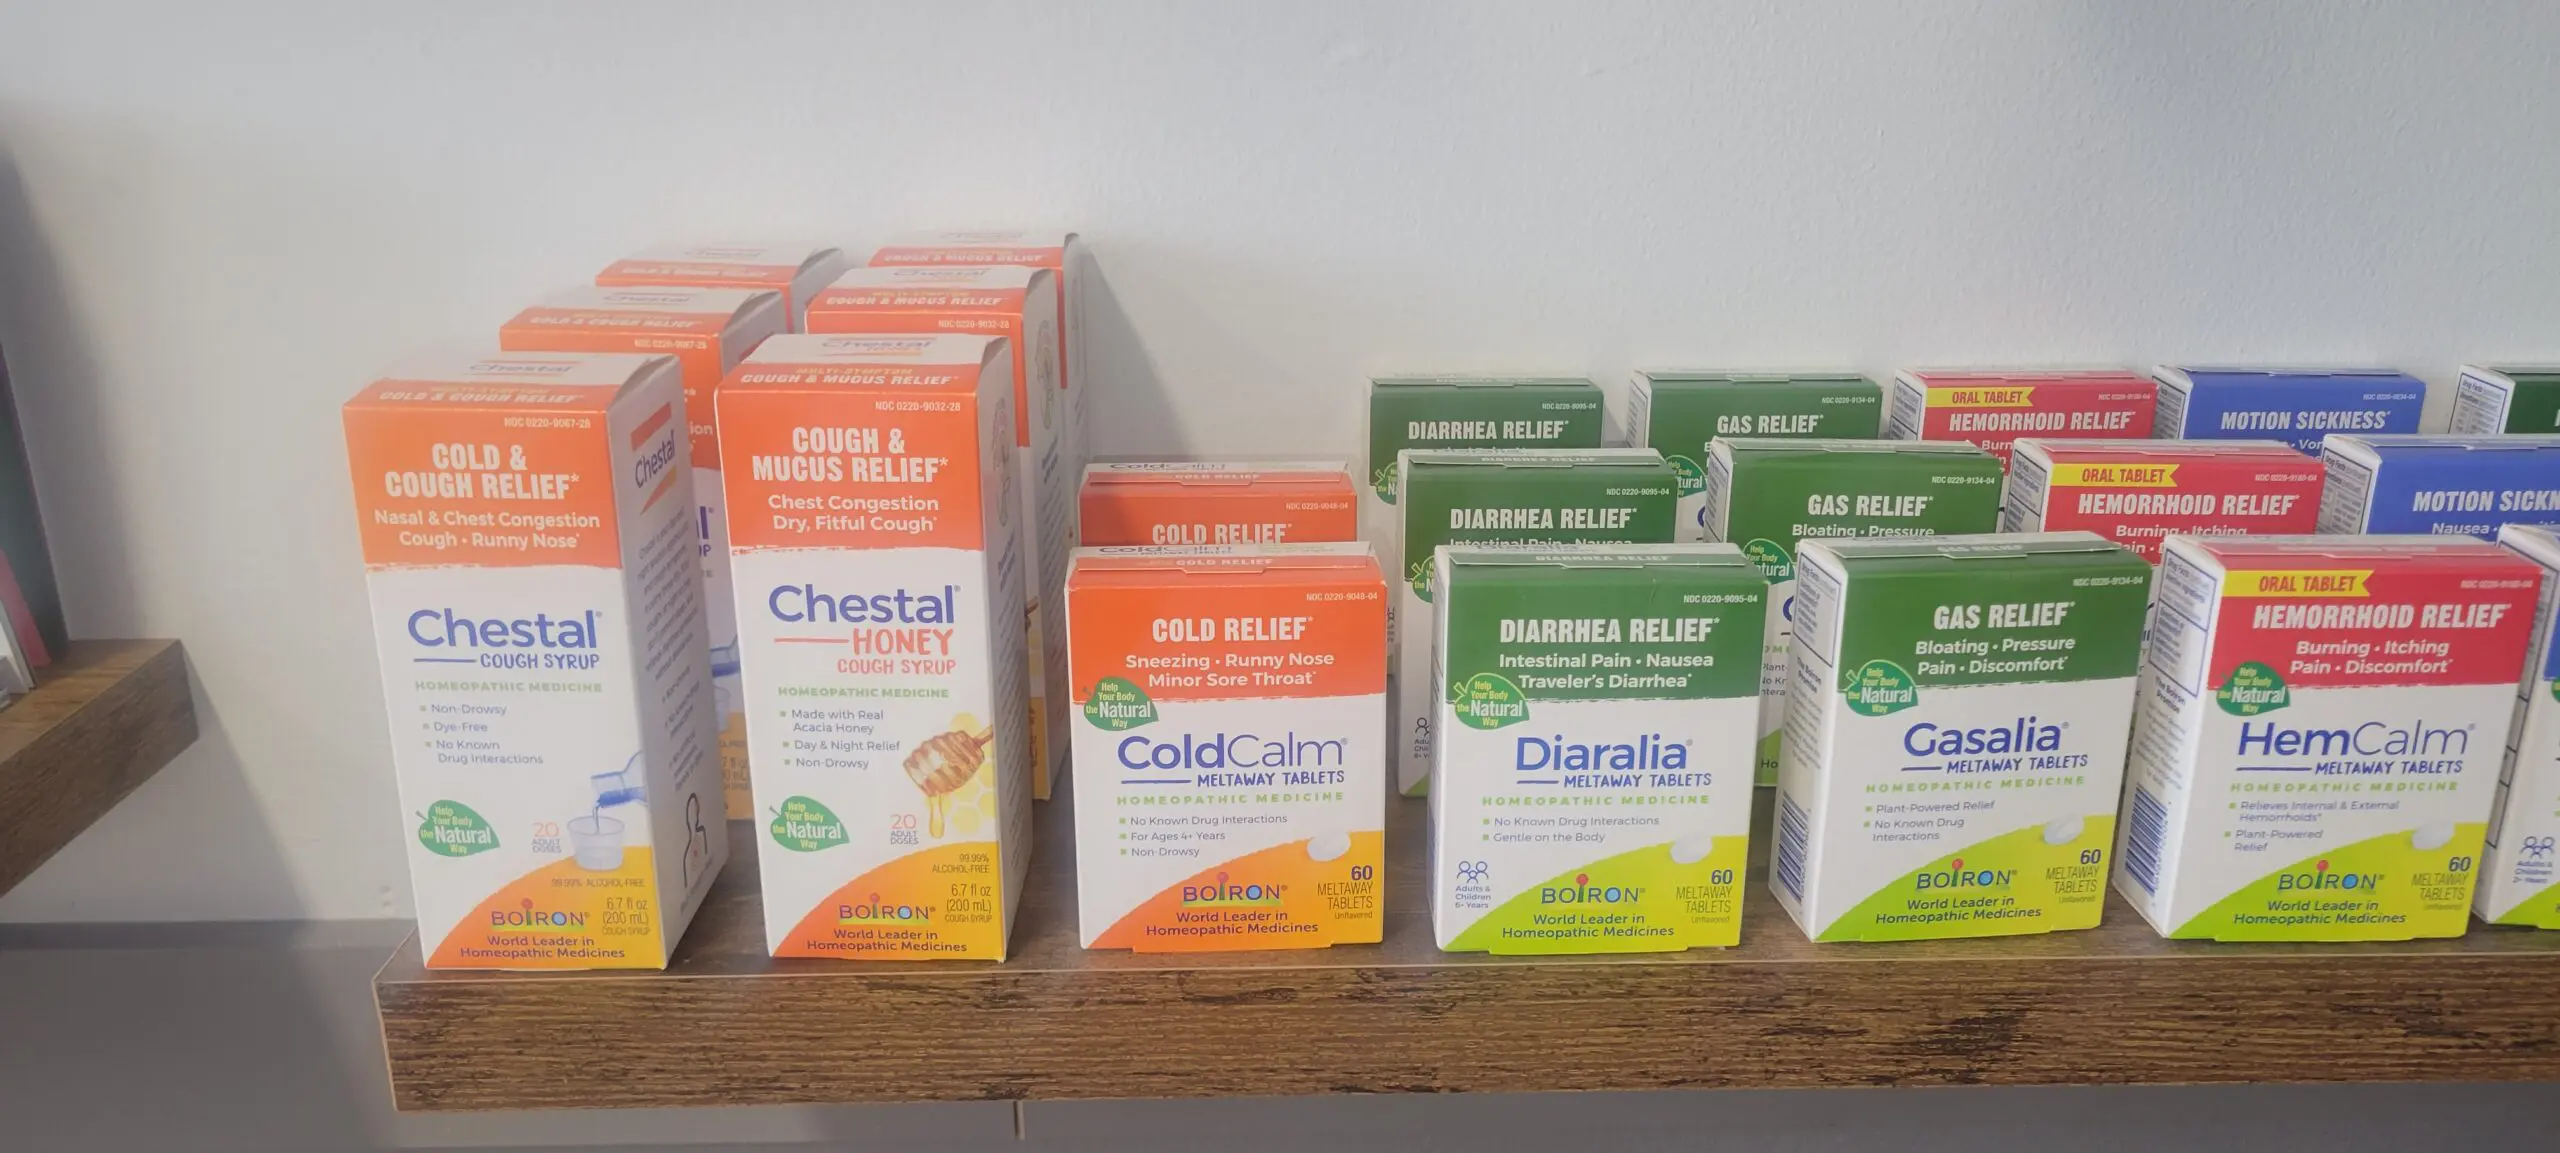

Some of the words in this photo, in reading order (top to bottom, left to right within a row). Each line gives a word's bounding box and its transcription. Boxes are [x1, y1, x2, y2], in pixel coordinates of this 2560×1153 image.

[741, 374, 801, 383] COUGH
[806, 374, 819, 383] &
[823, 375, 885, 384] MUCUS
[891, 375, 952, 385] RELIEF
[1952, 391, 1979, 404] ORAL
[1984, 391, 2023, 403] TABLET
[875, 401, 894, 411] NDC
[504, 418, 524, 428] NDC
[1717, 416, 1752, 434] GAS
[1950, 413, 2065, 431] HEMORRHOID
[2221, 412, 2291, 430] MOTION
[1408, 421, 1497, 440] DIARRHEA
[792, 427, 879, 453] COUGH
[888, 429, 905, 453] &
[432, 443, 501, 470] COLD
[510, 445, 527, 471] &
[634, 430, 676, 489] Chestal
[752, 456, 843, 482] MUCUS
[2082, 469, 2115, 483] ORAL
[2120, 469, 2166, 483] TABLET
[385, 472, 473, 498] COUGH
[1932, 476, 1946, 484] NDC
[768, 495, 824, 509] Chest
[828, 495, 939, 513] Congestion
[1808, 495, 1849, 516] GAS
[2078, 494, 2214, 515] HEMORRHOID
[2413, 491, 2492, 511] MOTION
[2499, 490, 2560, 511] SICKN
[374, 510, 423, 525] Nasal
[428, 511, 440, 526] &
[444, 511, 495, 527] Chest
[499, 512, 600, 531] Congestion
[773, 514, 810, 532] Dry,
[815, 515, 865, 530] Fitful
[1451, 509, 1554, 529] DIARRHEA
[1153, 524, 1206, 544] COLD
[2432, 523, 2489, 535] Nausea
[399, 532, 457, 549] Cough
[472, 533, 528, 551] Runny
[2259, 576, 2297, 592] ORAL
[2303, 576, 2357, 592] TABLET
[769, 584, 954, 624] Chestal
[1306, 593, 1322, 601] NDC
[1684, 595, 1700, 603] NDC
[1702, 595, 1757, 603] 0220-9095-04
[1934, 605, 1980, 629] GAS
[2253, 605, 2413, 628] HEMORRHOID
[407, 608, 597, 649] Chestal
[1152, 618, 1215, 642] COLD
[1500, 619, 1621, 643] DIARRHEA
[853, 628, 953, 656] HONEY
[1916, 640, 1988, 656] Bloating
[2002, 637, 2075, 652] Pressure
[2296, 641, 2369, 657] Burning
[2384, 641, 2449, 656] Itching
[480, 653, 538, 669] COUGH
[544, 654, 600, 669] SYRUP
[1126, 654, 1210, 670] Sneezing
[1225, 654, 1284, 670] Runny
[1289, 653, 1334, 666] Nose
[1500, 654, 1587, 668] Intestinal
[1591, 654, 1632, 668] Pain
[1646, 654, 1713, 668] Nausea
[1918, 660, 1955, 675] Pain
[2290, 661, 2330, 674] Pain
[1101, 683, 1118, 693] Help
[1149, 674, 1202, 688] Minor
[1206, 673, 1248, 686] Sore
[1519, 674, 1604, 689] Traveler's
[1099, 693, 1114, 701] Your
[1116, 692, 1135, 702] Body
[431, 704, 507, 716] Non-Drowsy
[792, 710, 825, 720] Made
[828, 710, 854, 720] with
[858, 710, 883, 720] Real
[1086, 705, 1098, 714] the
[1100, 702, 1150, 718] Natural
[434, 722, 488, 733] Dye-Free
[793, 723, 832, 732] Acacia
[836, 723, 874, 735] Honey
[1112, 719, 1128, 729] Way
[1903, 716, 2061, 757] Gasalia
[2238, 720, 2468, 756] HemCalm
[1118, 732, 1342, 769] ColdCalm
[1516, 734, 1687, 771] Diaralia
[1198, 773, 1277, 787] MELTAWAY
[1284, 770, 1344, 784] TABLETS
[1117, 795, 1247, 805] HOMEOPATHIC
[1256, 792, 1344, 803] MEDICINE
[2241, 801, 2288, 811] Relieves
[2292, 801, 2336, 811] Internal
[2339, 801, 2347, 810] &
[2351, 801, 2399, 810] External
[1876, 802, 1959, 814] Plant-Powered
[1963, 800, 1994, 811] Relief
[891, 815, 916, 829] 20
[1131, 817, 1146, 825] No
[1150, 816, 1188, 825] Known
[1192, 816, 1219, 827] Drug
[1222, 814, 1287, 824] Interactions
[1131, 832, 1148, 841] For
[1151, 832, 1178, 843] Ages
[1181, 832, 1193, 840] 4+
[1196, 831, 1225, 840] Years
[1494, 832, 1531, 842] Gentle
[1535, 834, 1550, 842] on
[1553, 833, 1571, 842] the
[1575, 832, 1605, 844] Body
[959, 854, 989, 863] 99.99%
[932, 864, 989, 873] ALCOHOL-FREE
[1351, 866, 1372, 881] 60
[951, 884, 968, 897] 6.7
[971, 885, 977, 896] fl
[980, 886, 991, 897] oz
[1183, 872, 1280, 901] BOIRON
[1317, 883, 1372, 896] MELTAWAY
[946, 899, 969, 913] (200
[973, 900, 991, 913] mL)
[1328, 896, 1372, 910] TABLETS
[1534, 914, 1576, 925] World
[1581, 914, 1628, 924] Leader
[1632, 914, 1644, 924] in
[1502, 928, 1599, 939] Homeopathic
[1604, 926, 1674, 937] Medicines
